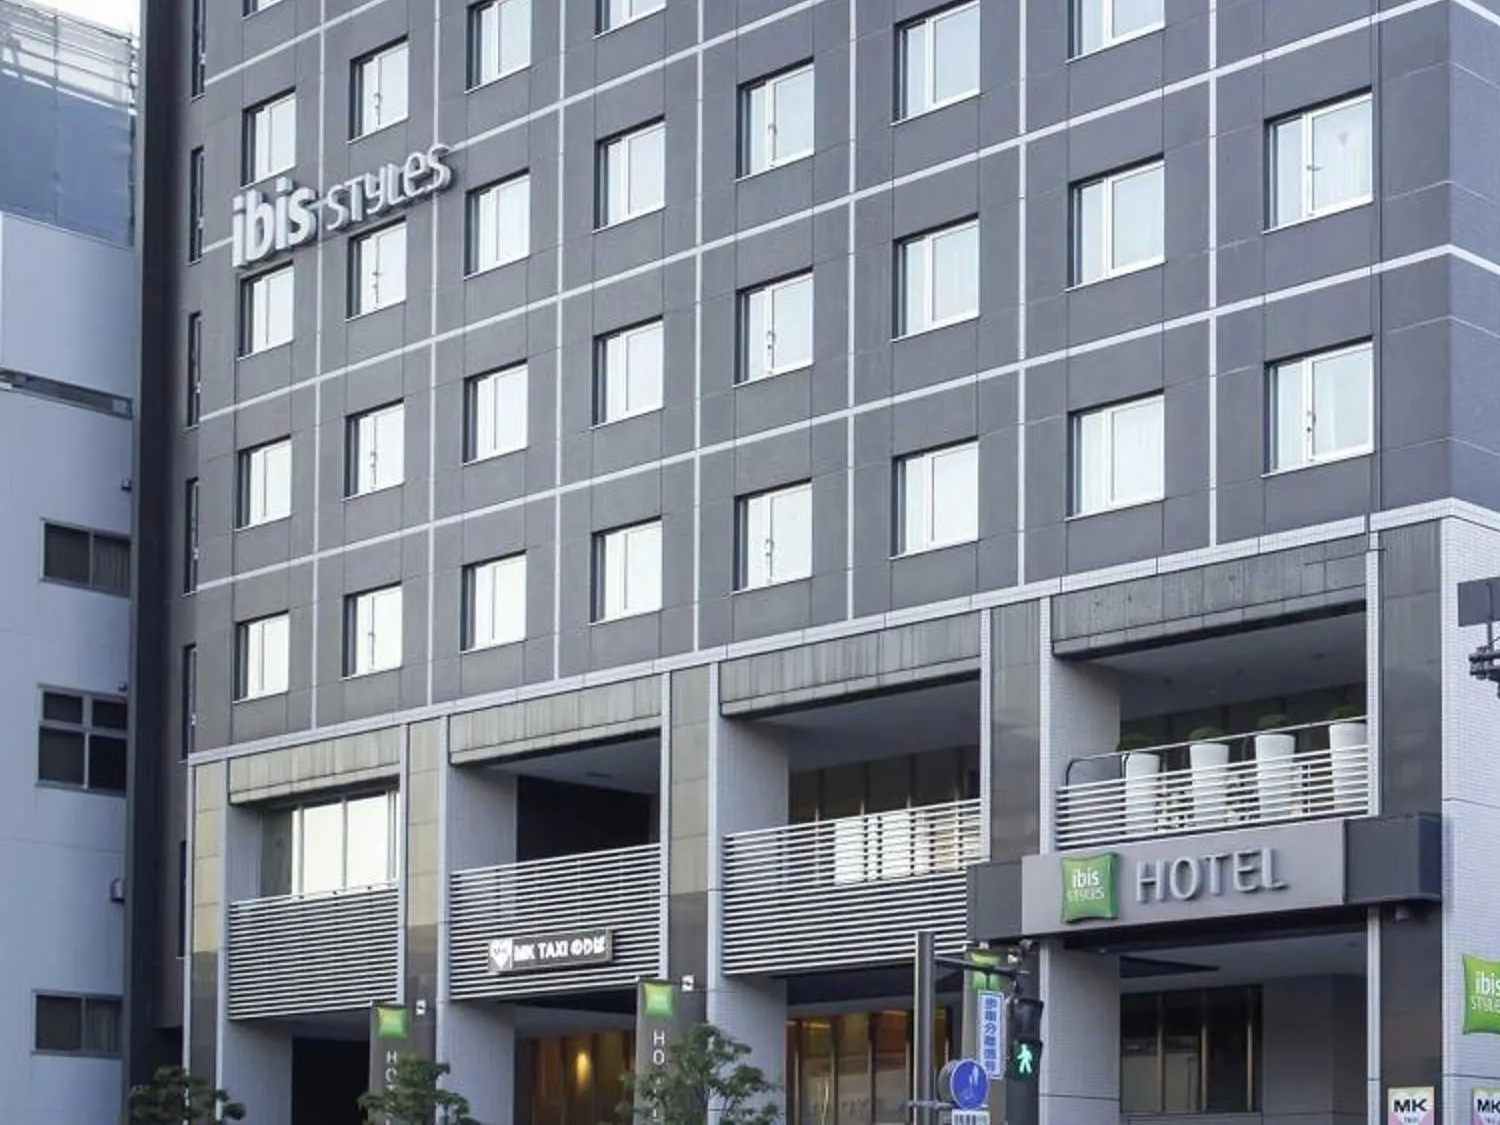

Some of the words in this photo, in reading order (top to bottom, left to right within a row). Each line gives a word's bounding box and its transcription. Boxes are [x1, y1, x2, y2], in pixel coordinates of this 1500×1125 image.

[232, 177, 318, 267] ibis
[1072, 867, 1099, 888] ibis
[1136, 846, 1287, 903] HOTEL
[513, 944, 536, 961] MK
[538, 940, 569, 959] TAXI
[1393, 1098, 1428, 1113] MK
